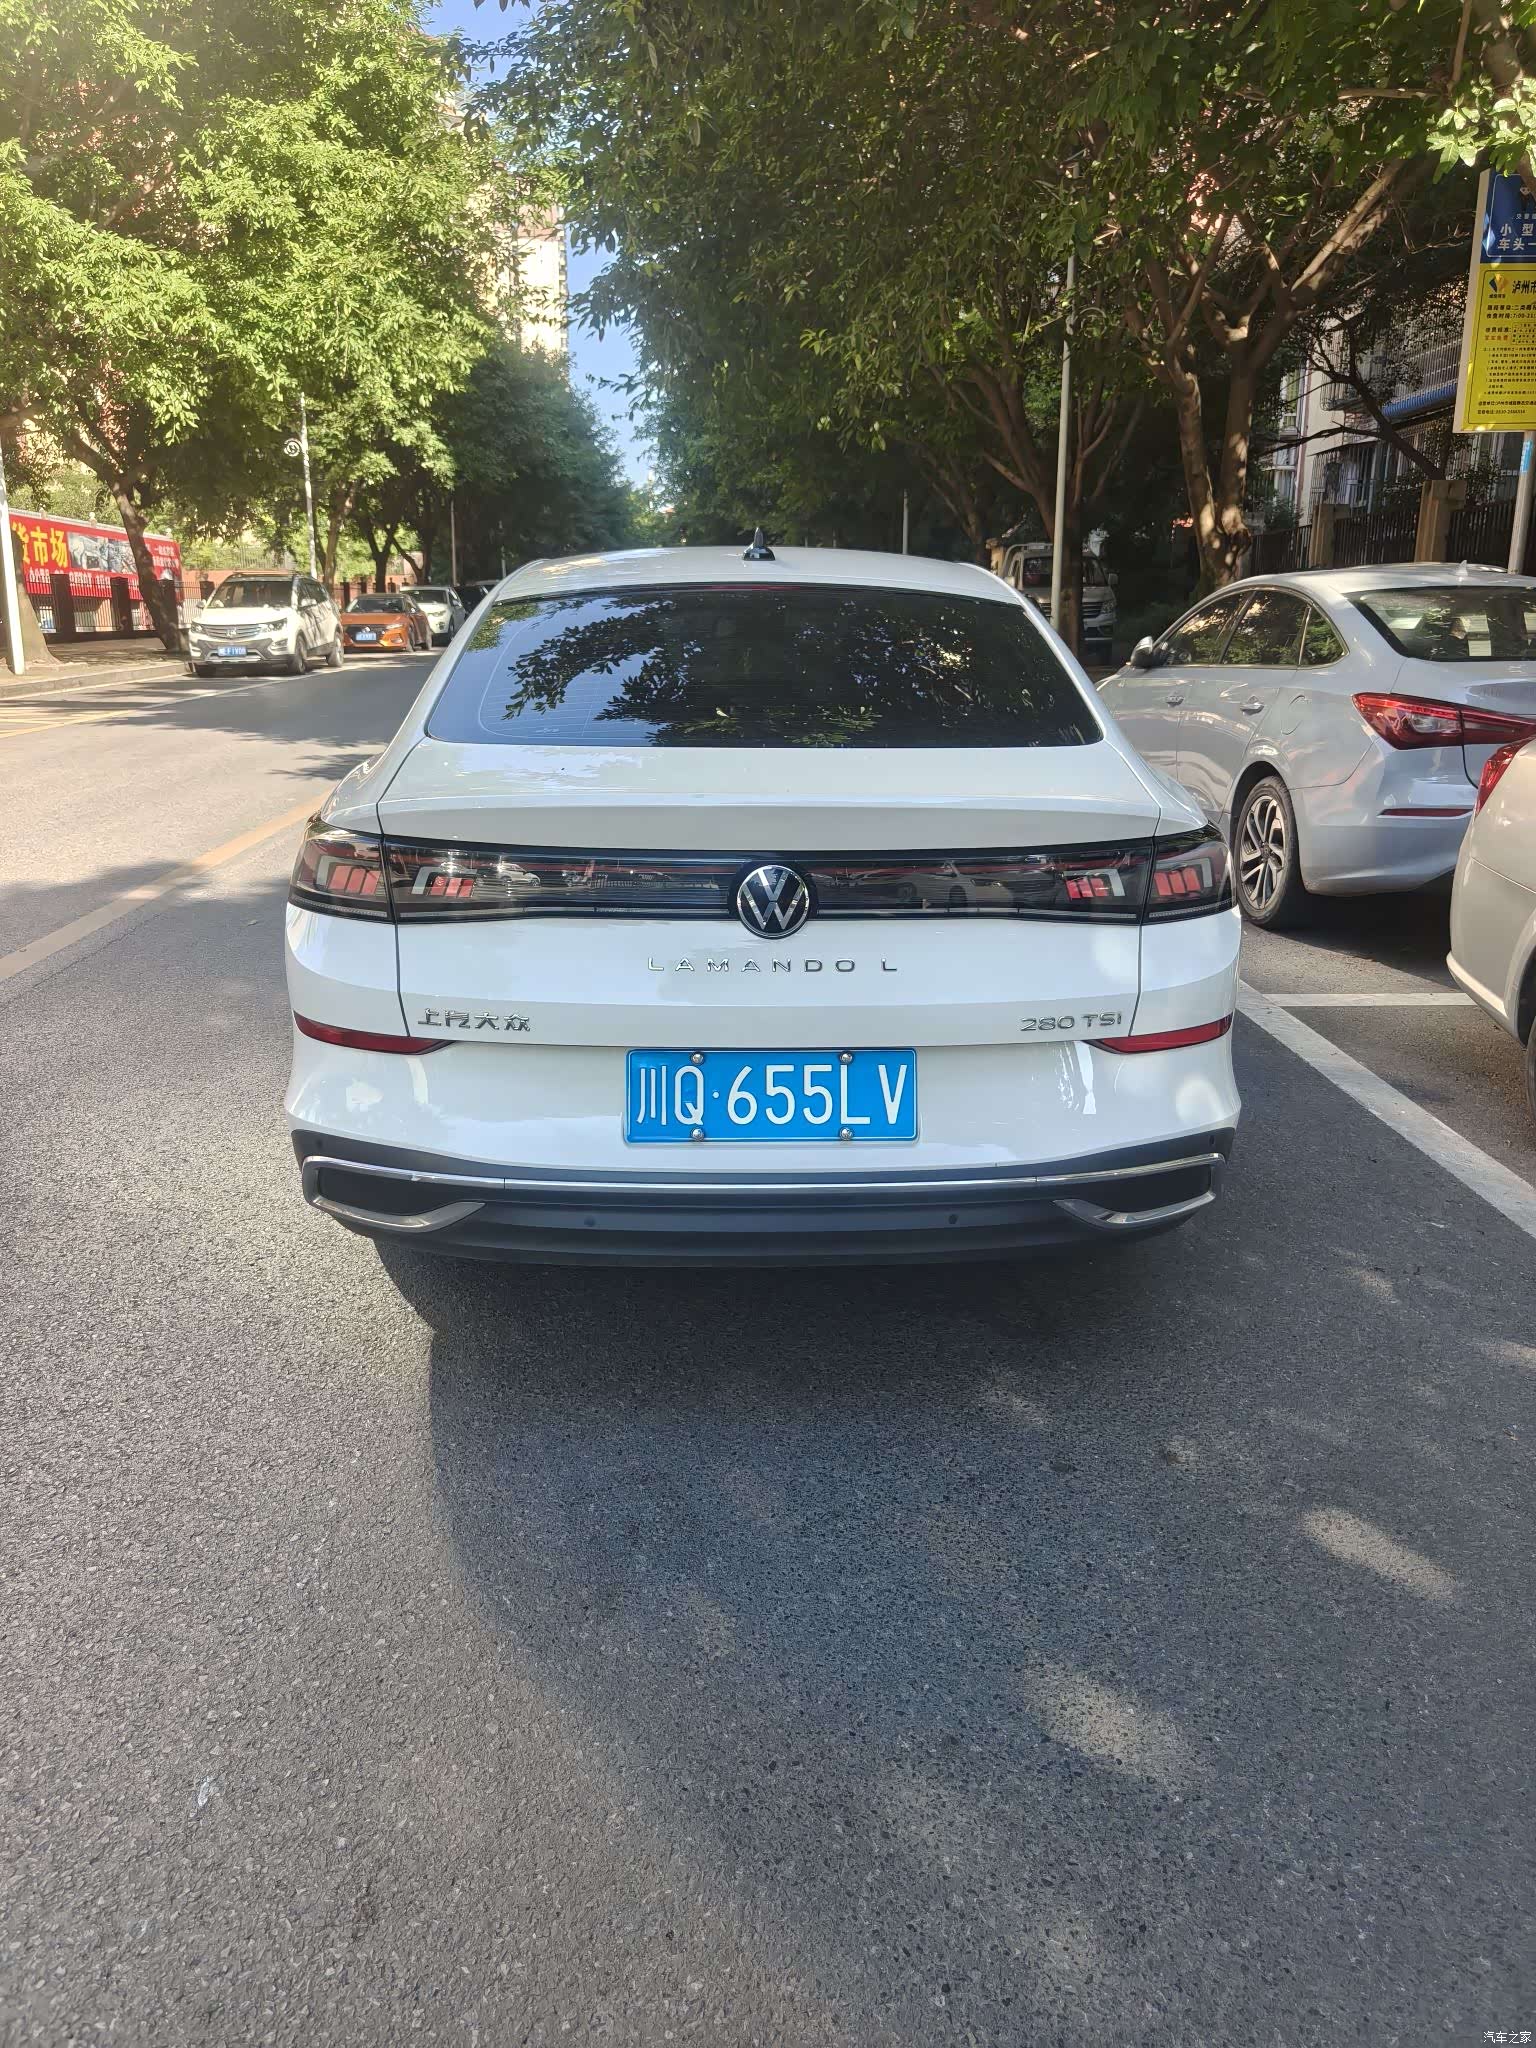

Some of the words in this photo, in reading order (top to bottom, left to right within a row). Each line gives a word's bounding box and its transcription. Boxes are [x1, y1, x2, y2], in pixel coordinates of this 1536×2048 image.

[1500, 223, 1534, 236] 小型
[648, 957, 856, 972] LAMANDO
[881, 958, 898, 971] L
[418, 1007, 531, 1032] 上汽大众
[1020, 1015, 1075, 1032] 280
[1081, 1010, 1122, 1028] TSI
[636, 1064, 908, 1126] 川Q·655LV
